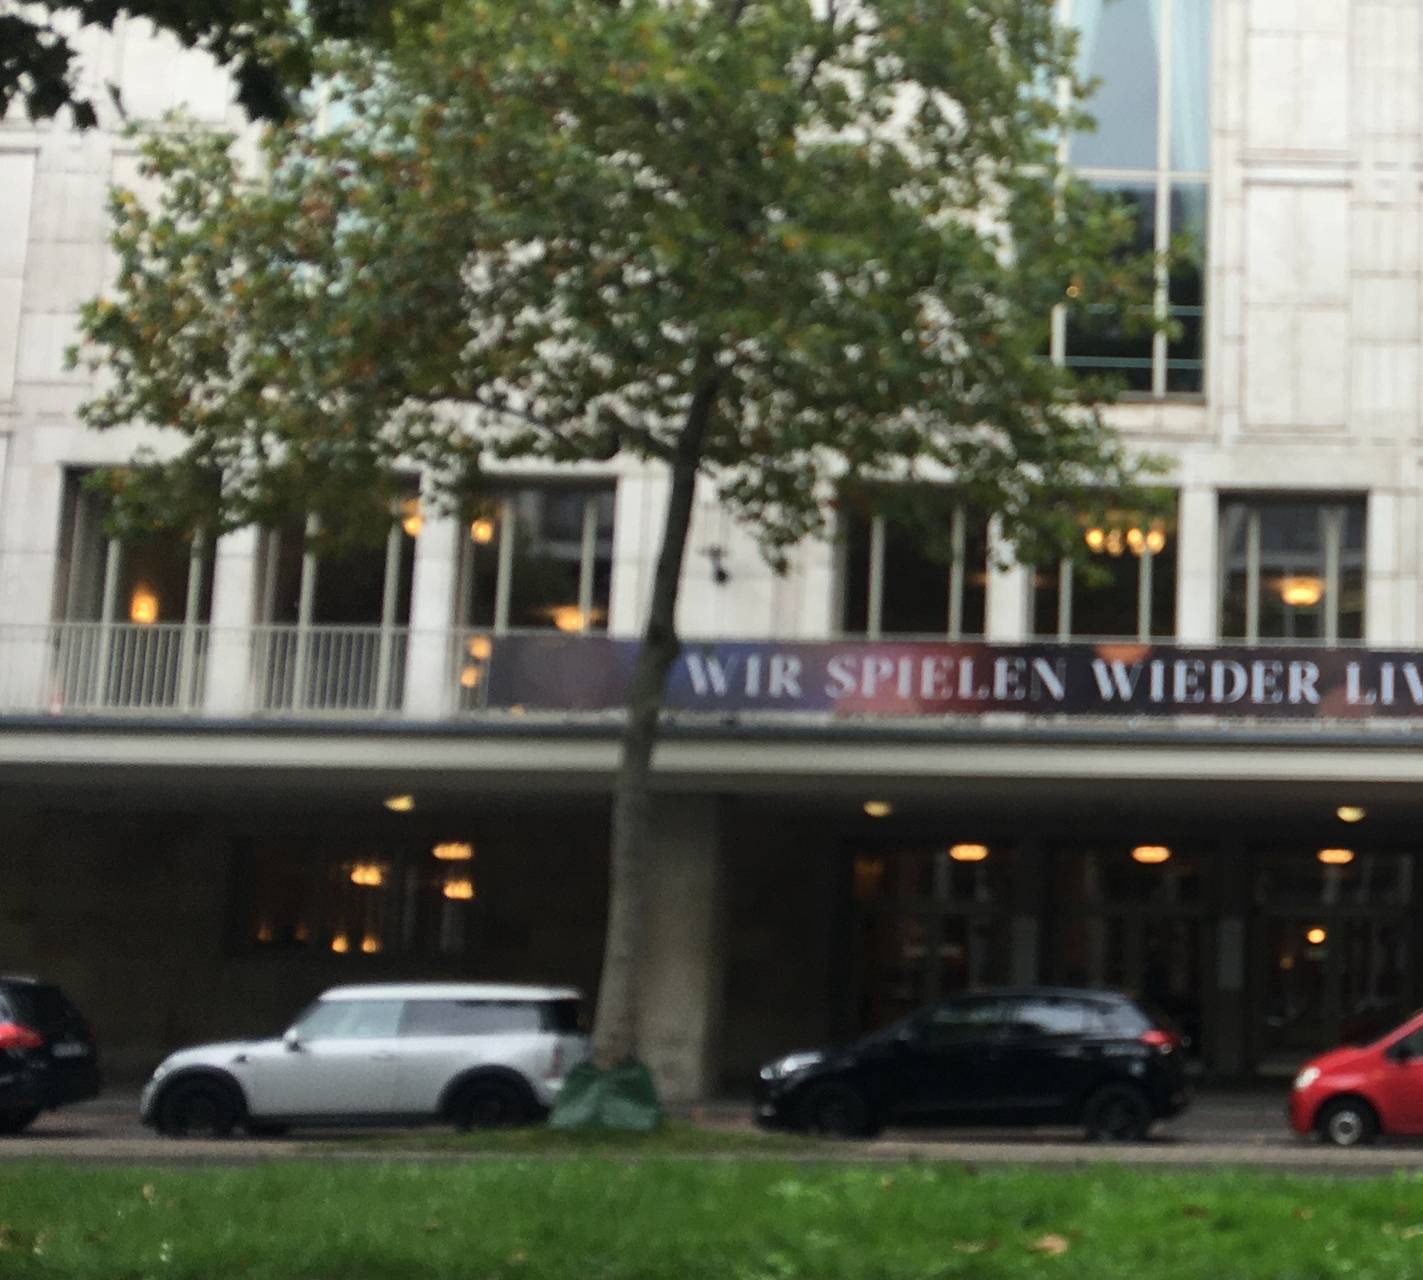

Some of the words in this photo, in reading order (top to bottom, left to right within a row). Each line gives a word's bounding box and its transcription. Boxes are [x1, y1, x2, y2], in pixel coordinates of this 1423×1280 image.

[685, 655, 801, 698] WIR
[824, 655, 1067, 701] SPIELEN
[1092, 658, 1321, 704] WIEDER
